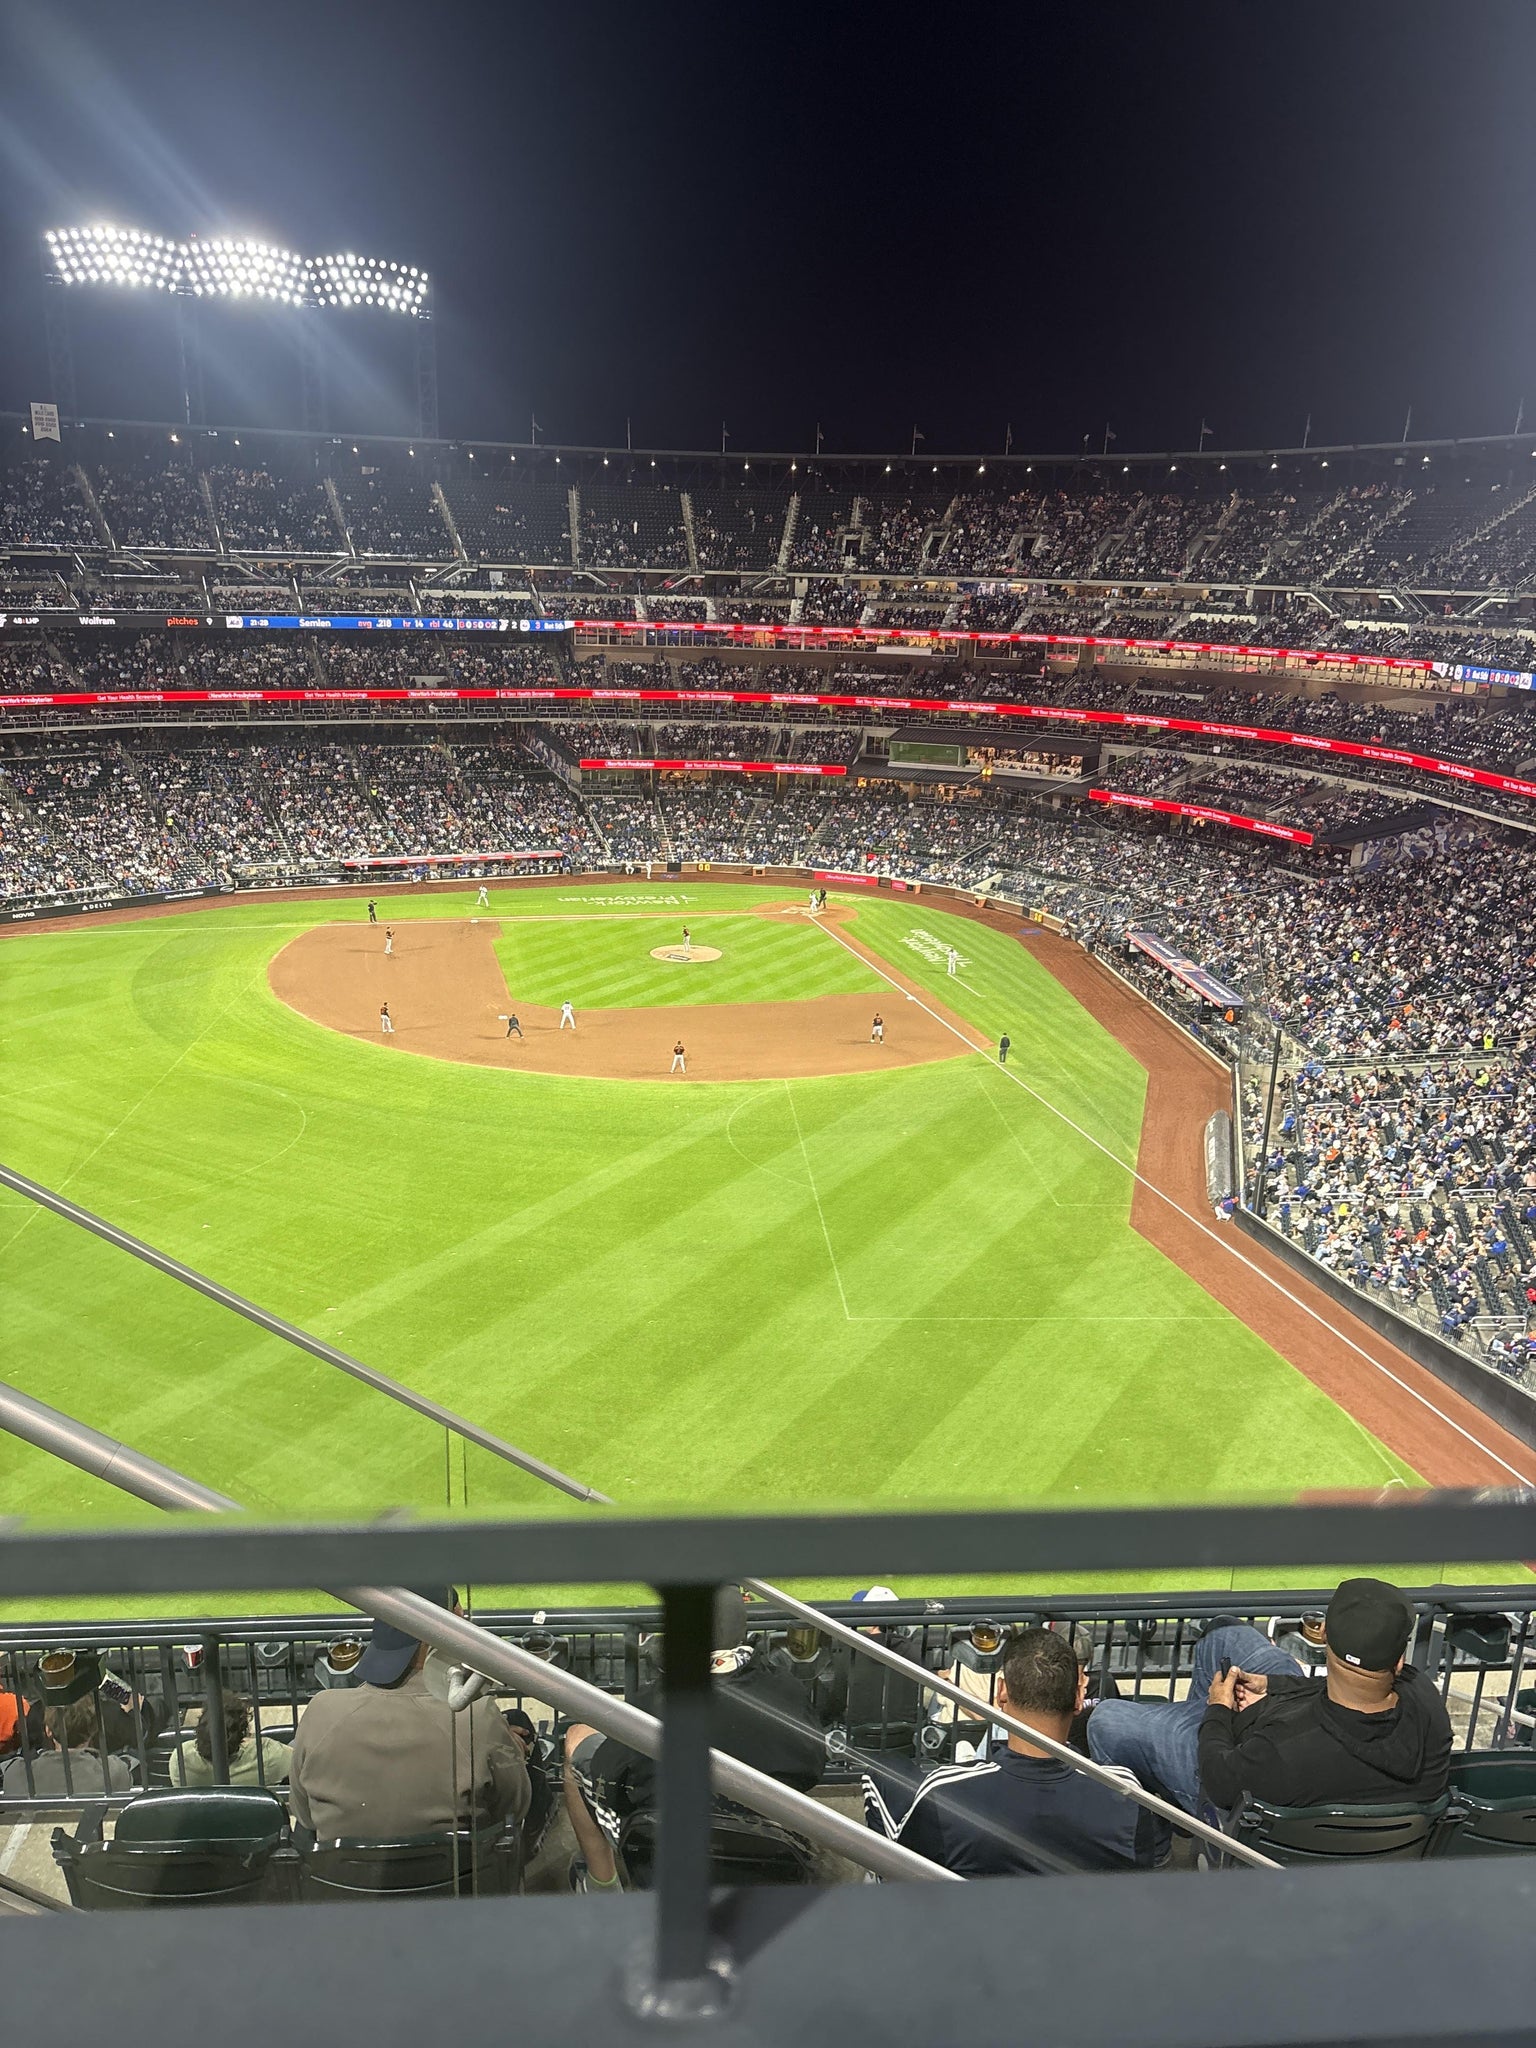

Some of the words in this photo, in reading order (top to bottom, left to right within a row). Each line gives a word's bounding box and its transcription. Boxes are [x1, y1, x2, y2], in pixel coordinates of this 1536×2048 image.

[79, 616, 116, 625] Wolfram
[167, 617, 199, 627] pitches
[206, 618, 213, 626] 9
[299, 618, 332, 627] Semien
[358, 621, 373, 629] avg
[376, 619, 392, 628] .218
[403, 619, 411, 628] hr
[415, 619, 424, 628] 14
[429, 619, 440, 628] rbi
[442, 620, 454, 628] 46
[459, 621, 465, 629] B
[465, 621, 472, 629] 0
[473, 621, 478, 629] S
[478, 621, 485, 629] 0
[491, 621, 498, 629] 2
[511, 621, 518, 629] 2
[535, 621, 541, 629] 3
[1448, 666, 1454, 677] 2
[1465, 668, 1471, 679] 3
